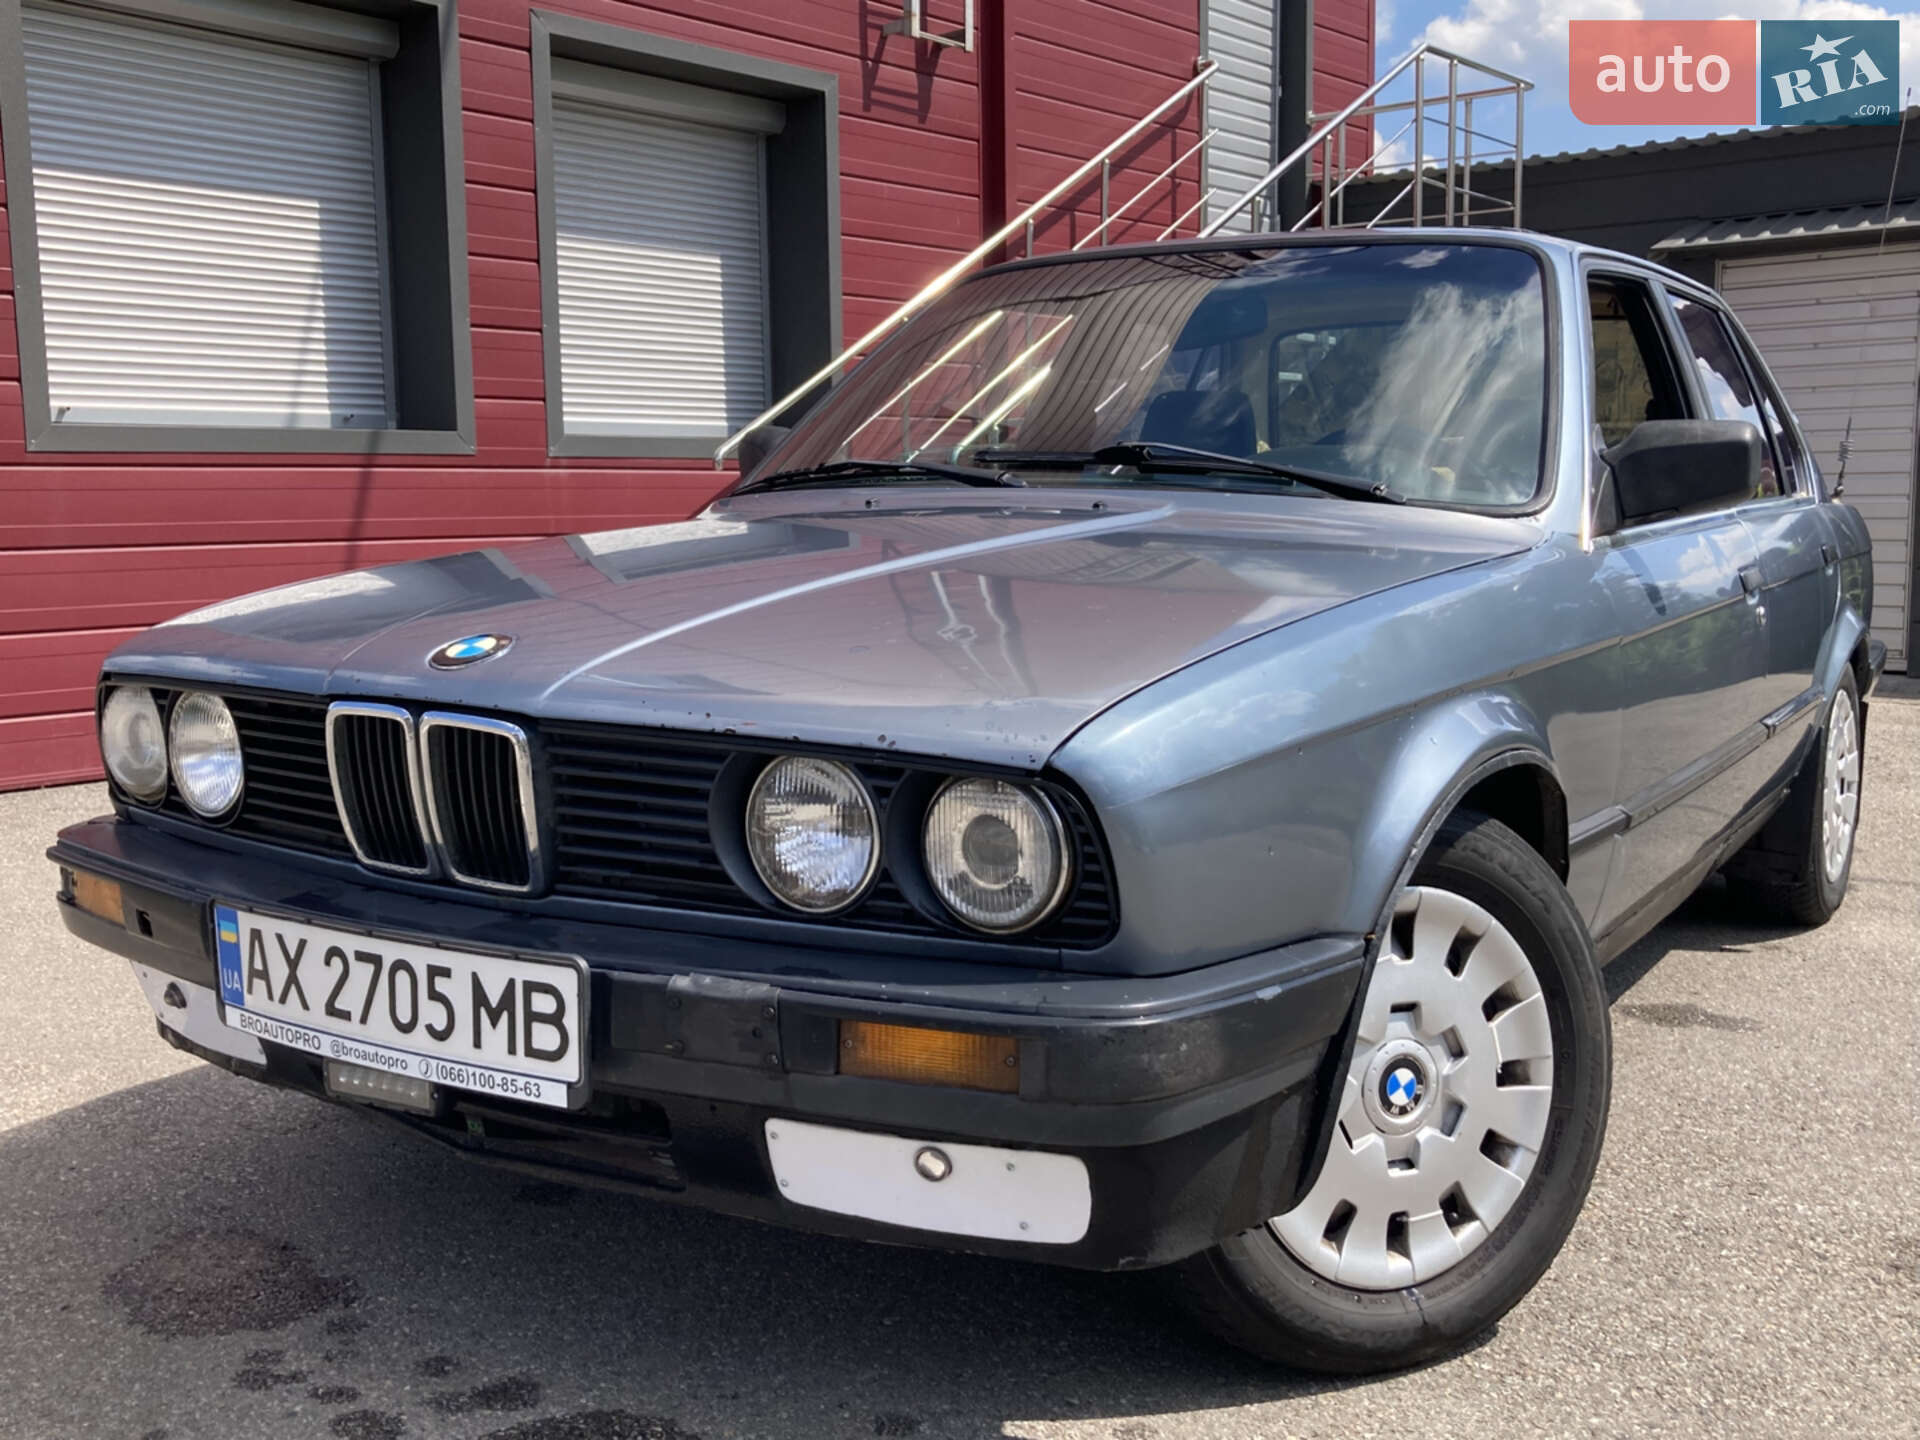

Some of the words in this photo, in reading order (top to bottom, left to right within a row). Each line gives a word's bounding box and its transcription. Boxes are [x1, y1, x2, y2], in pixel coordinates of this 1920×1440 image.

[223, 968, 242, 992] UA
[247, 928, 310, 1011] AX
[324, 945, 455, 1042] 2705
[471, 971, 569, 1062] MB
[240, 1014, 321, 1050] BROAUTOPRO
[330, 1039, 408, 1071] @broautopro
[435, 1062, 541, 1098] (066)100-85-63
